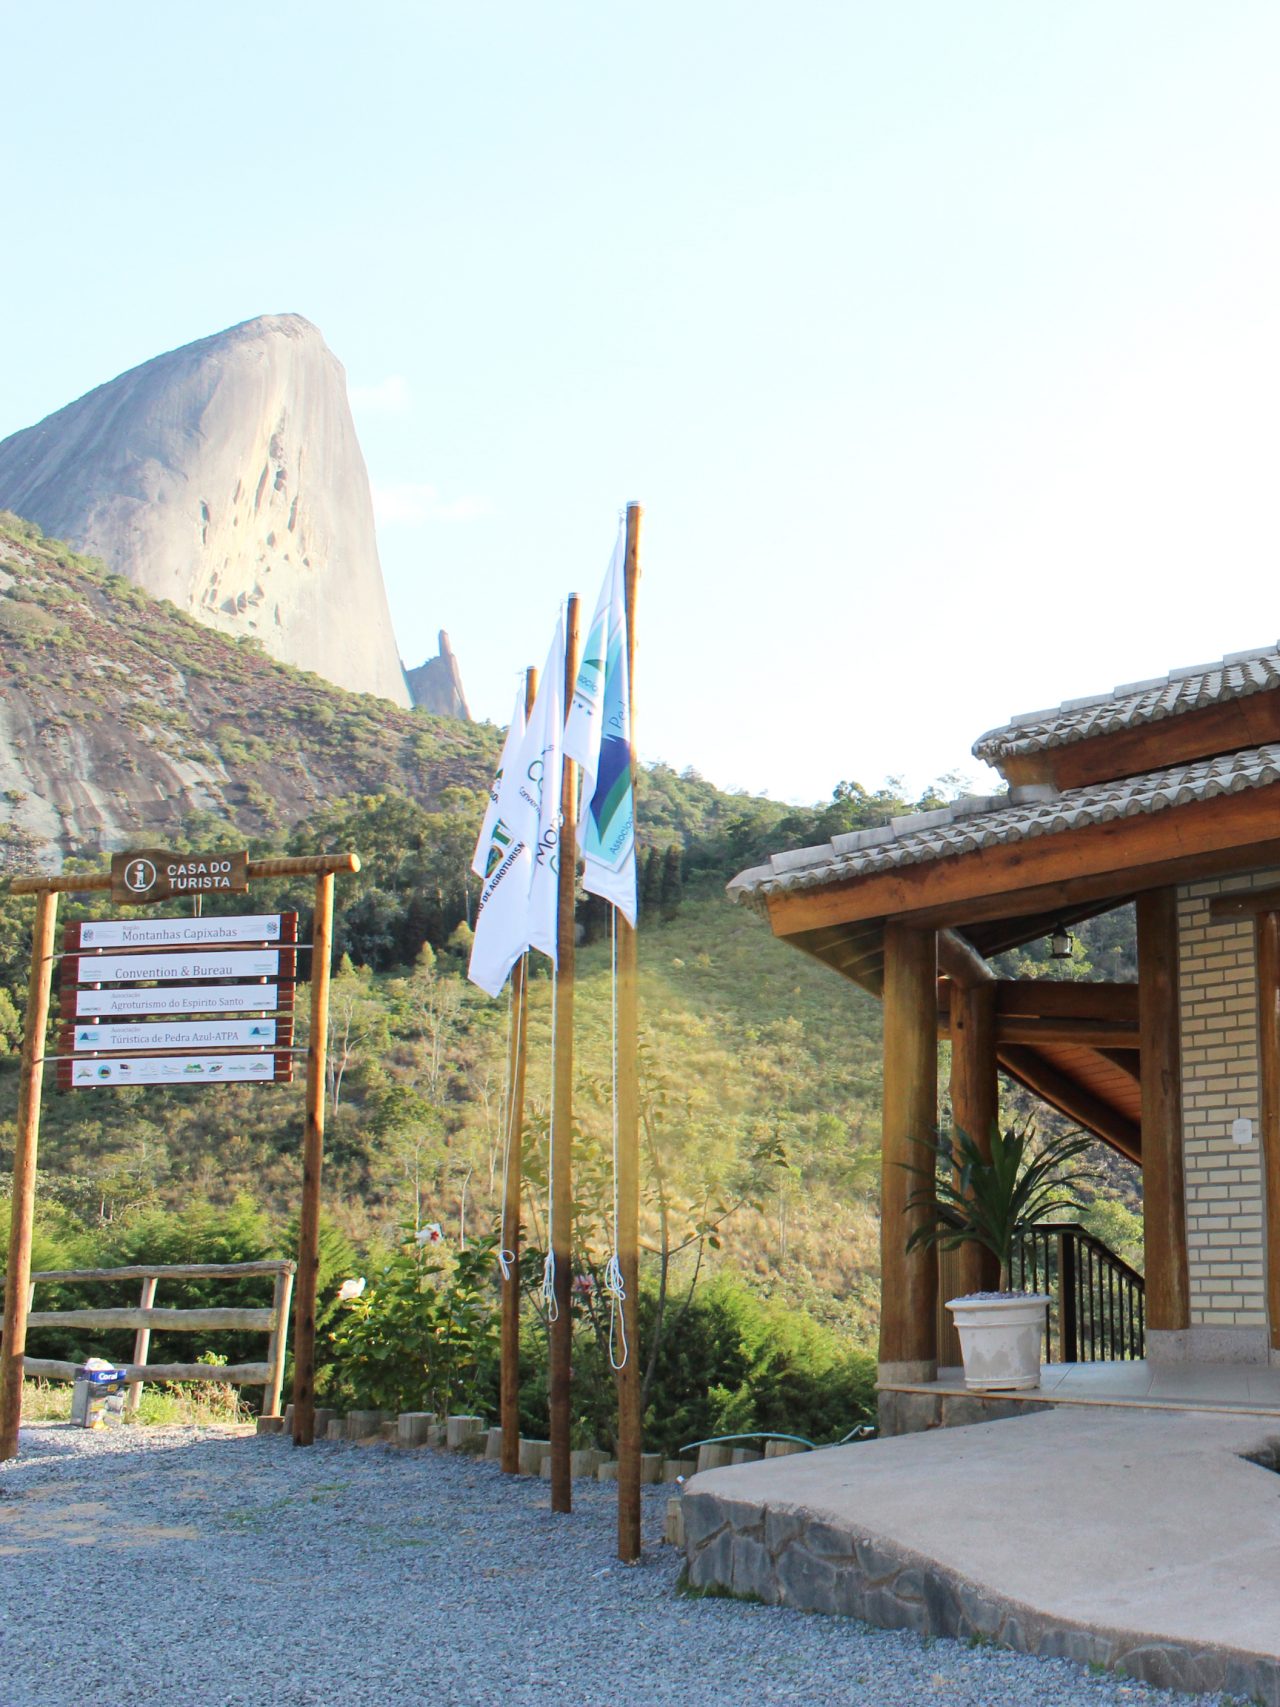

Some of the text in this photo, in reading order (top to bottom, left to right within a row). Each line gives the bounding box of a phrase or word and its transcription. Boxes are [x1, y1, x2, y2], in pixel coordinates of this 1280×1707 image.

[167, 861, 231, 876] CASA DO
[168, 876, 231, 889] TURISTA
[121, 929, 181, 942] Montanhas
[183, 926, 238, 940] Capixabas
[115, 966, 178, 980] Convention
[181, 965, 190, 976] &
[193, 964, 233, 977] Bureau
[111, 999, 167, 1011] Agroturismo
[168, 998, 180, 1008] do
[219, 996, 244, 1007] Santo
[152, 1033, 163, 1044] de
[165, 1032, 190, 1044] Pedra
[192, 1030, 239, 1042] Azul-ATPA
[98, 1372, 118, 1380] Coral
